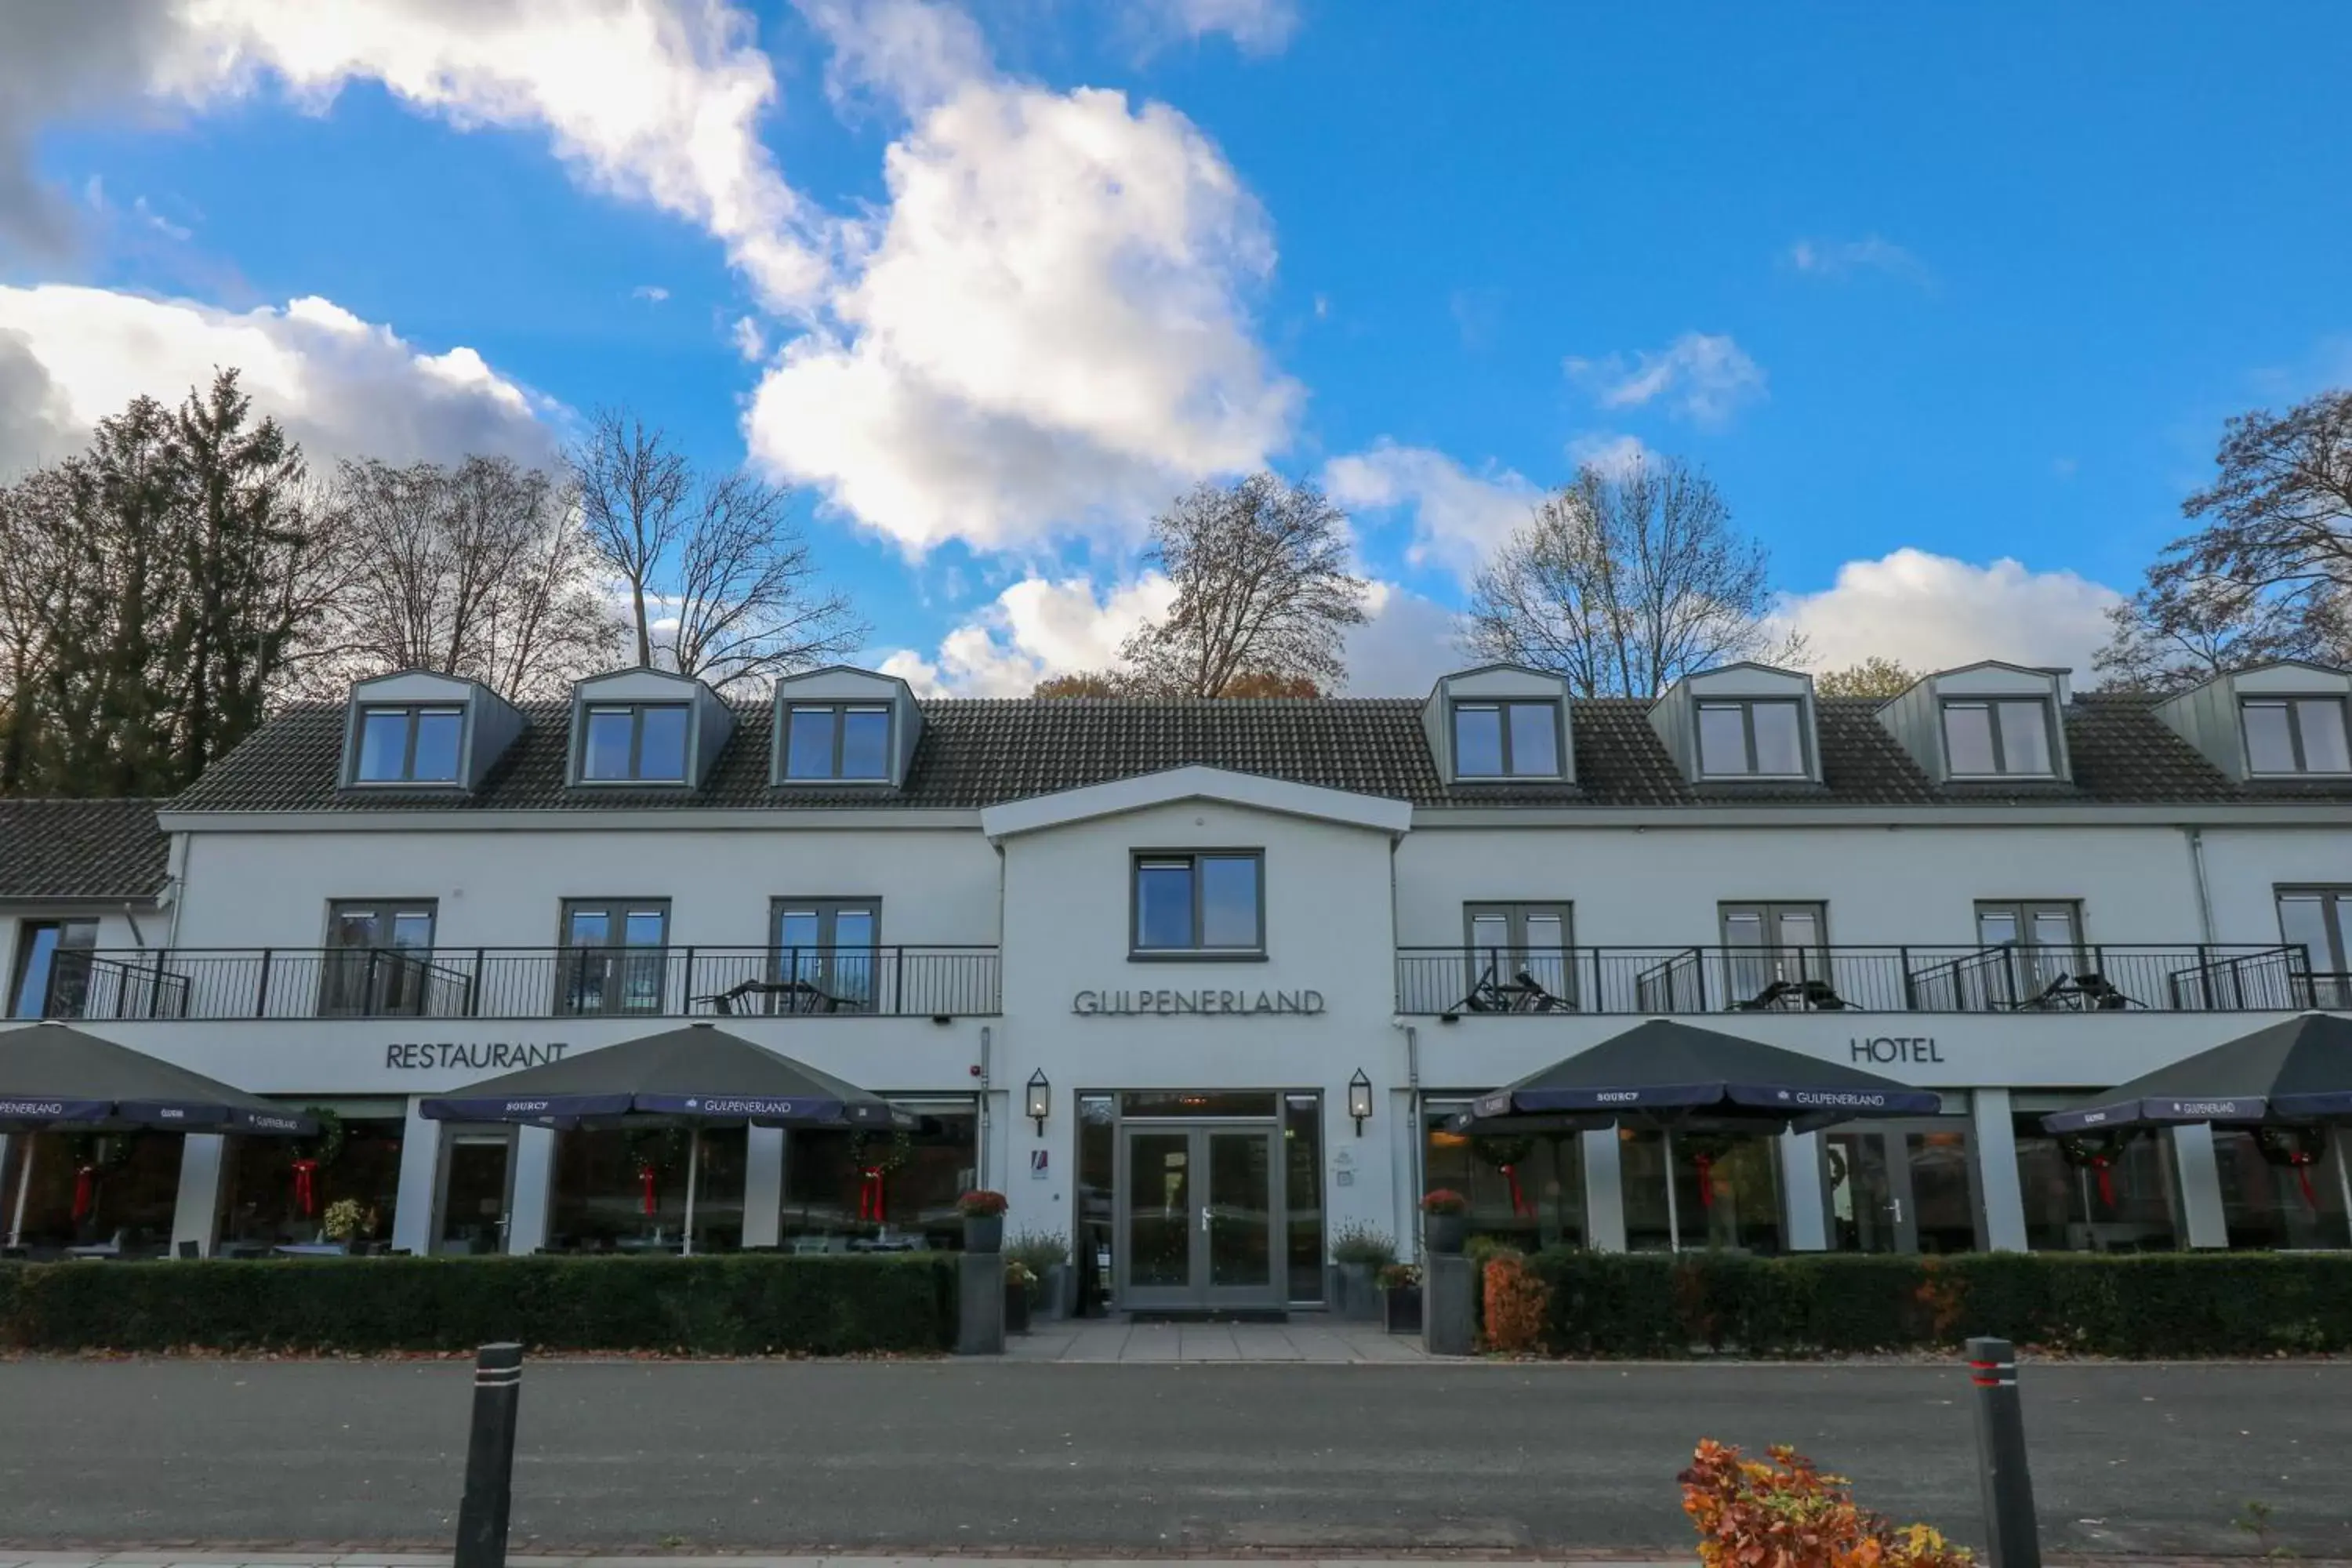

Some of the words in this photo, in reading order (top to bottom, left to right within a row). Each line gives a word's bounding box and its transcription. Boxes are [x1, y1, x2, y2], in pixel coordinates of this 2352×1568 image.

[1072, 989, 1326, 1017] GULPENERLAND
[387, 1043, 568, 1069] RESTAURANT
[1850, 1037, 1944, 1063] HOTEL
[705, 1100, 791, 1112] GULPENERLAND
[1796, 1092, 1885, 1106] GULPENERLAND
